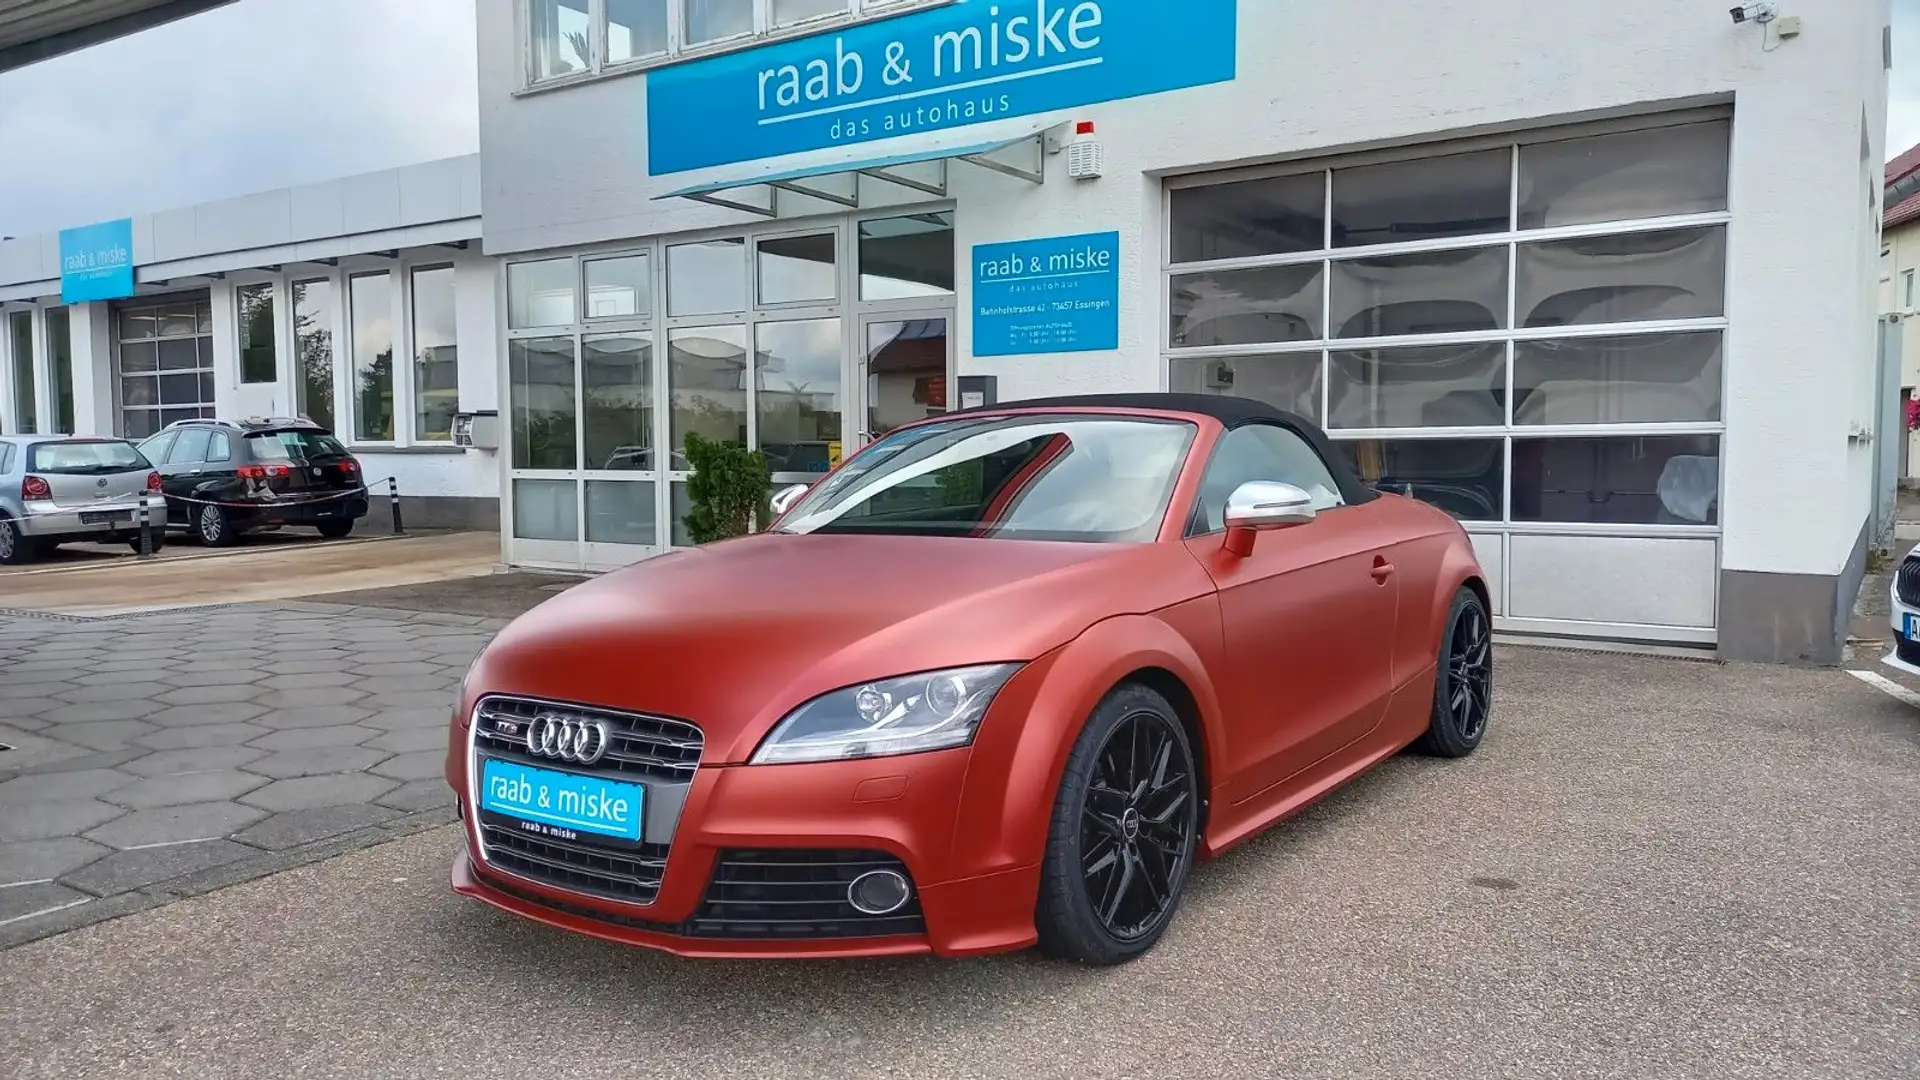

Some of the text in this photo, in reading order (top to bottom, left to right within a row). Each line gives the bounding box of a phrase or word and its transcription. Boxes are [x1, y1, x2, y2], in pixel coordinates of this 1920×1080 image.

[758, 0, 1102, 110] raab & miske
[830, 94, 1009, 140] das autohaus
[64, 249, 87, 270] raab
[97, 243, 128, 266] miske
[980, 245, 1110, 277] raab & miske
[1009, 280, 1079, 293] das autohaus
[980, 305, 1036, 316] Bahnhofstrasse
[1075, 299, 1110, 310] Essingen
[497, 721, 518, 735] TTS
[490, 773, 628, 821] raab & miske
[521, 821, 577, 840] raab & miske
